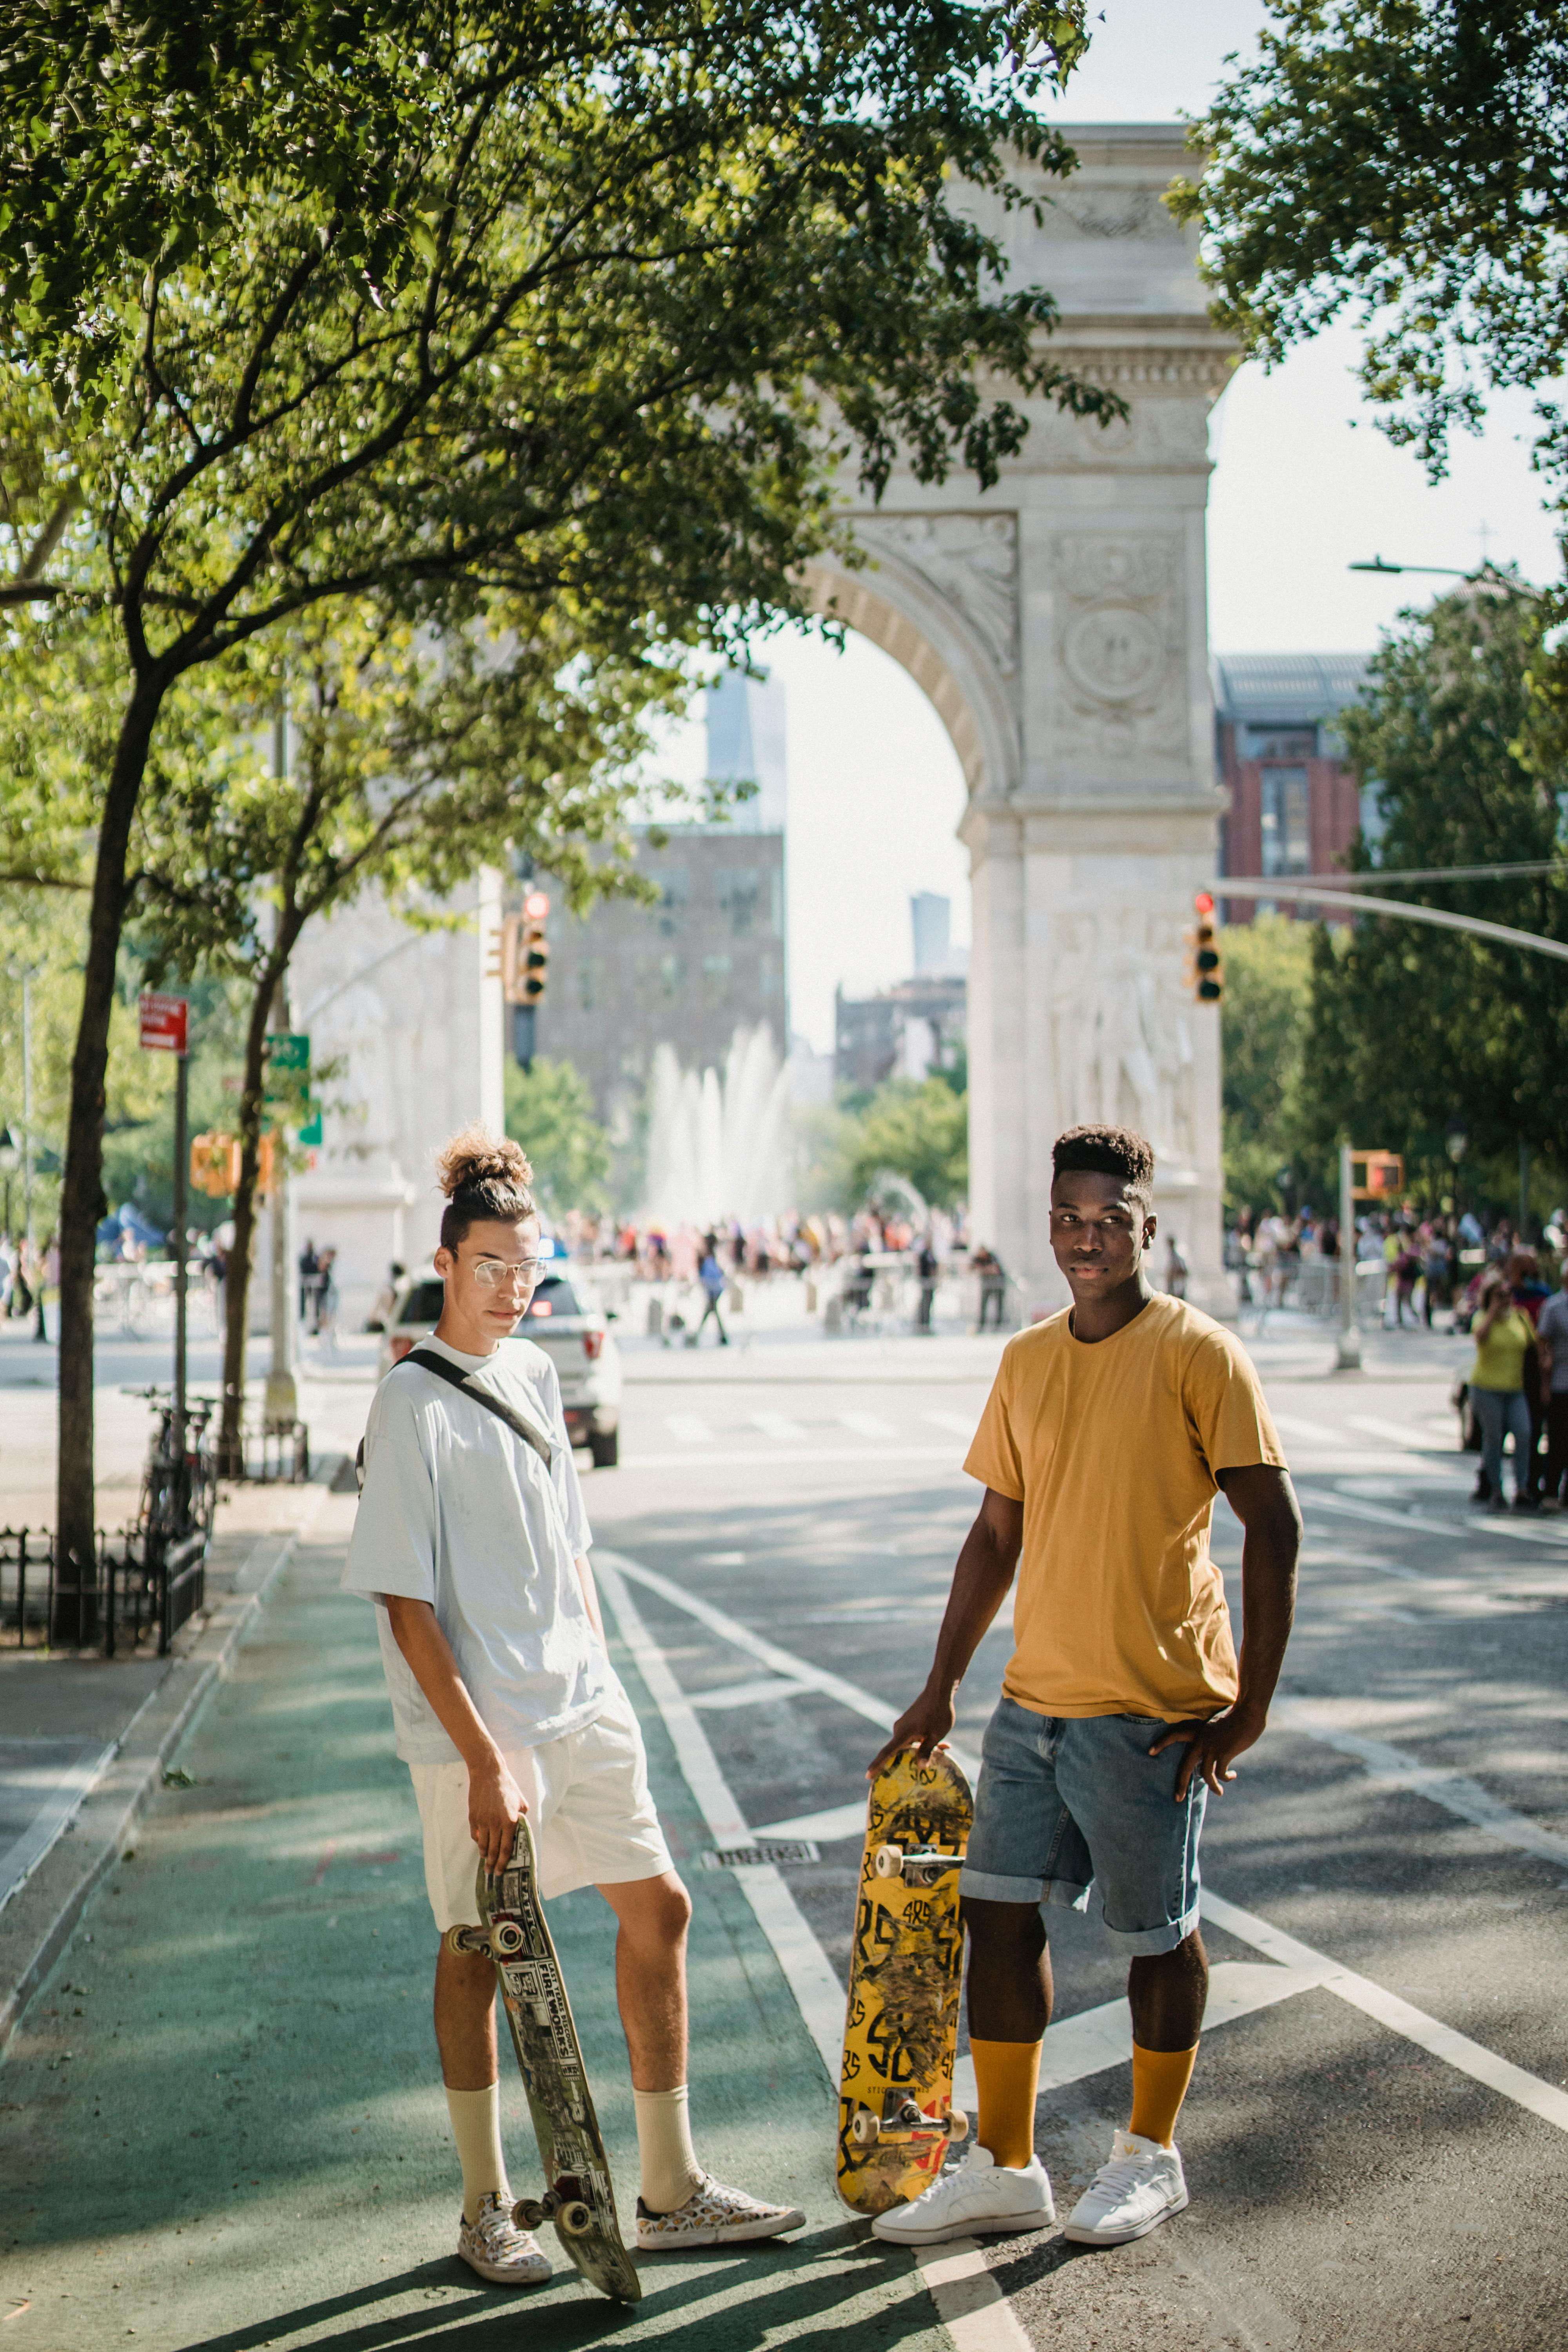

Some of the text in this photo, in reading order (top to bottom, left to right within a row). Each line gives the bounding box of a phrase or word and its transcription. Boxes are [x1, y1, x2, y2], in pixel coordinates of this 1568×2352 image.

[539, 1964, 568, 2056] FIREWORKS
[548, 1963, 557, 1983] LAST
[561, 2015, 575, 2054] DISCOUNT
